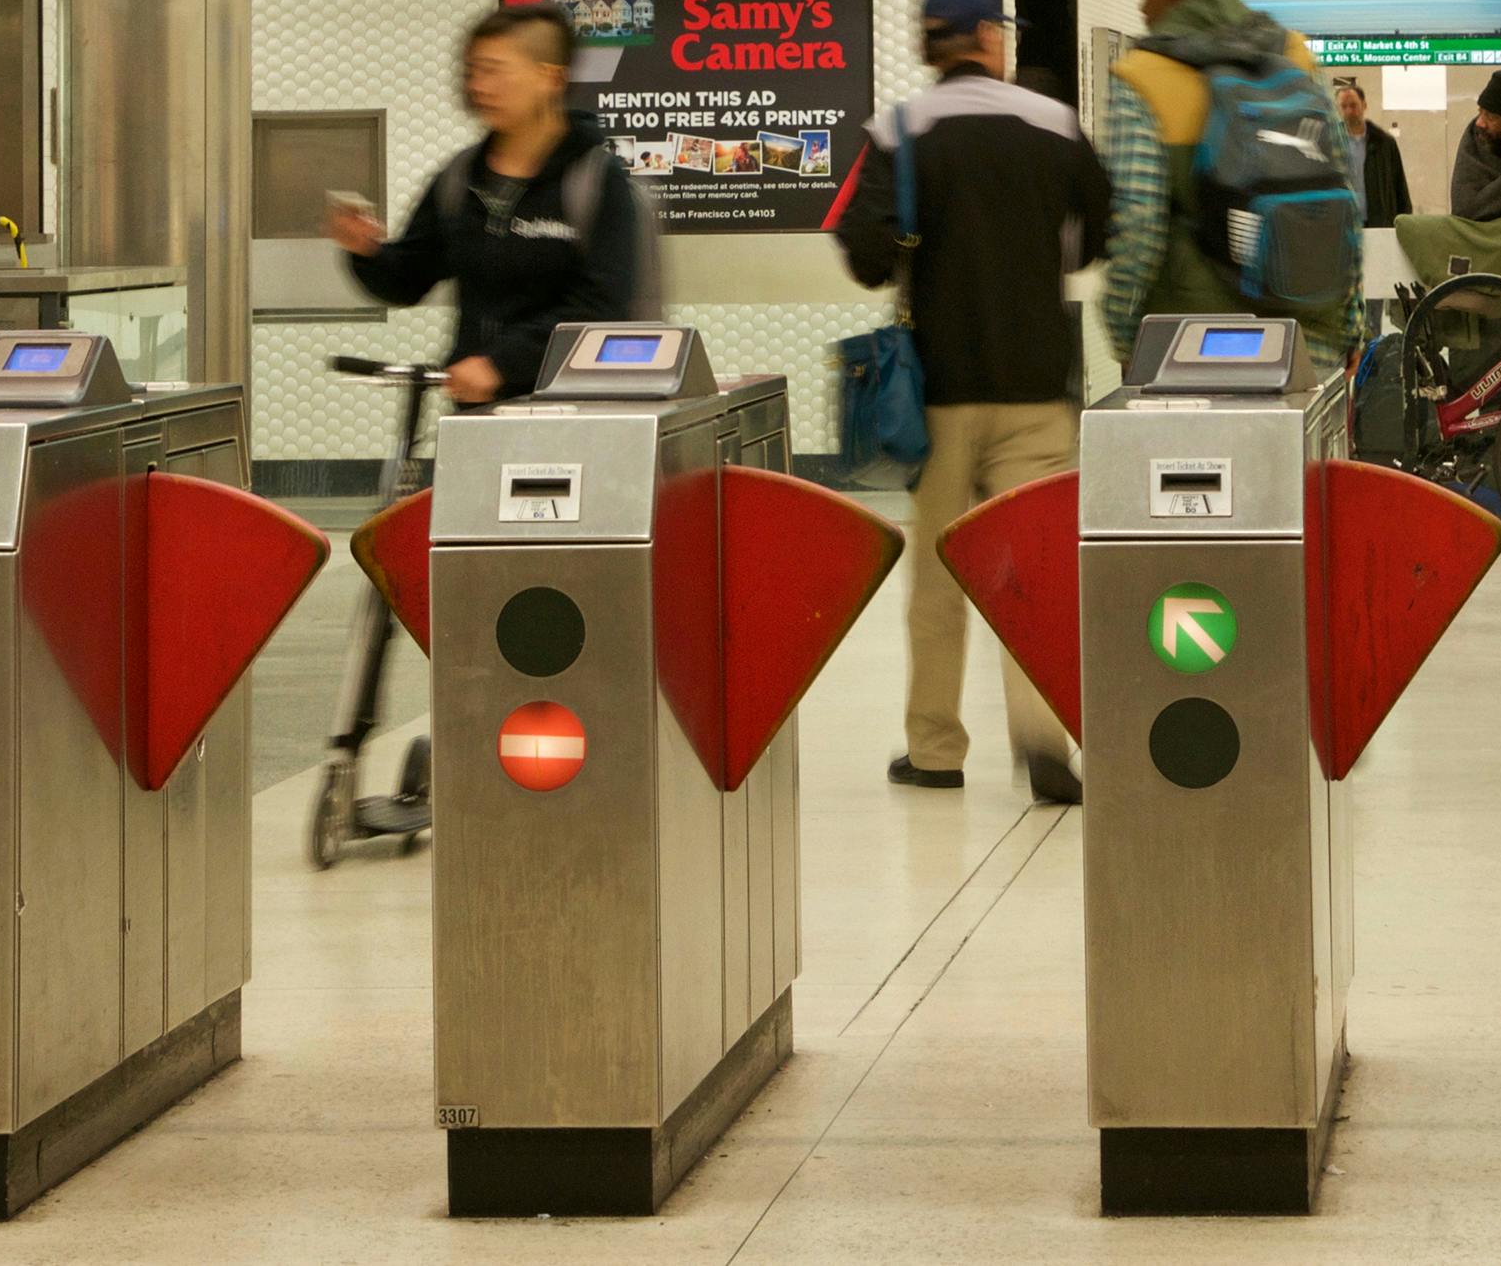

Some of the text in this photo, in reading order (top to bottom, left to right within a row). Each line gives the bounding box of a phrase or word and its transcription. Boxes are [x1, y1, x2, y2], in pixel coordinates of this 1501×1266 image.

[1328, 40, 1430, 50] Exit A4 Market & 4th St
[670, 33, 846, 71] Camera
[1326, 54, 1333, 62] &
[1335, 54, 1349, 62] 4th
[1350, 54, 1362, 63] St,
[1364, 53, 1401, 62] Moscone
[1403, 53, 1431, 62] Center
[1438, 53, 1455, 61] Exit
[598, 90, 776, 109] MENTION THIS AD
[596, 113, 619, 128] ET
[623, 112, 659, 128] 100
[664, 111, 715, 127] FREE
[720, 110, 760, 126] 4X6
[669, 183, 679, 191] be
[680, 183, 718, 191] redeemed
[729, 182, 762, 191] onetime,
[778, 182, 797, 190] store
[798, 181, 809, 189] for
[811, 181, 838, 190] details.
[663, 192, 681, 200] from
[682, 191, 697, 199] film
[707, 192, 738, 200] memory
[740, 191, 759, 199] card.
[658, 209, 775, 219] St San Francisco CA 94103
[438, 1108, 477, 1124] 3307
